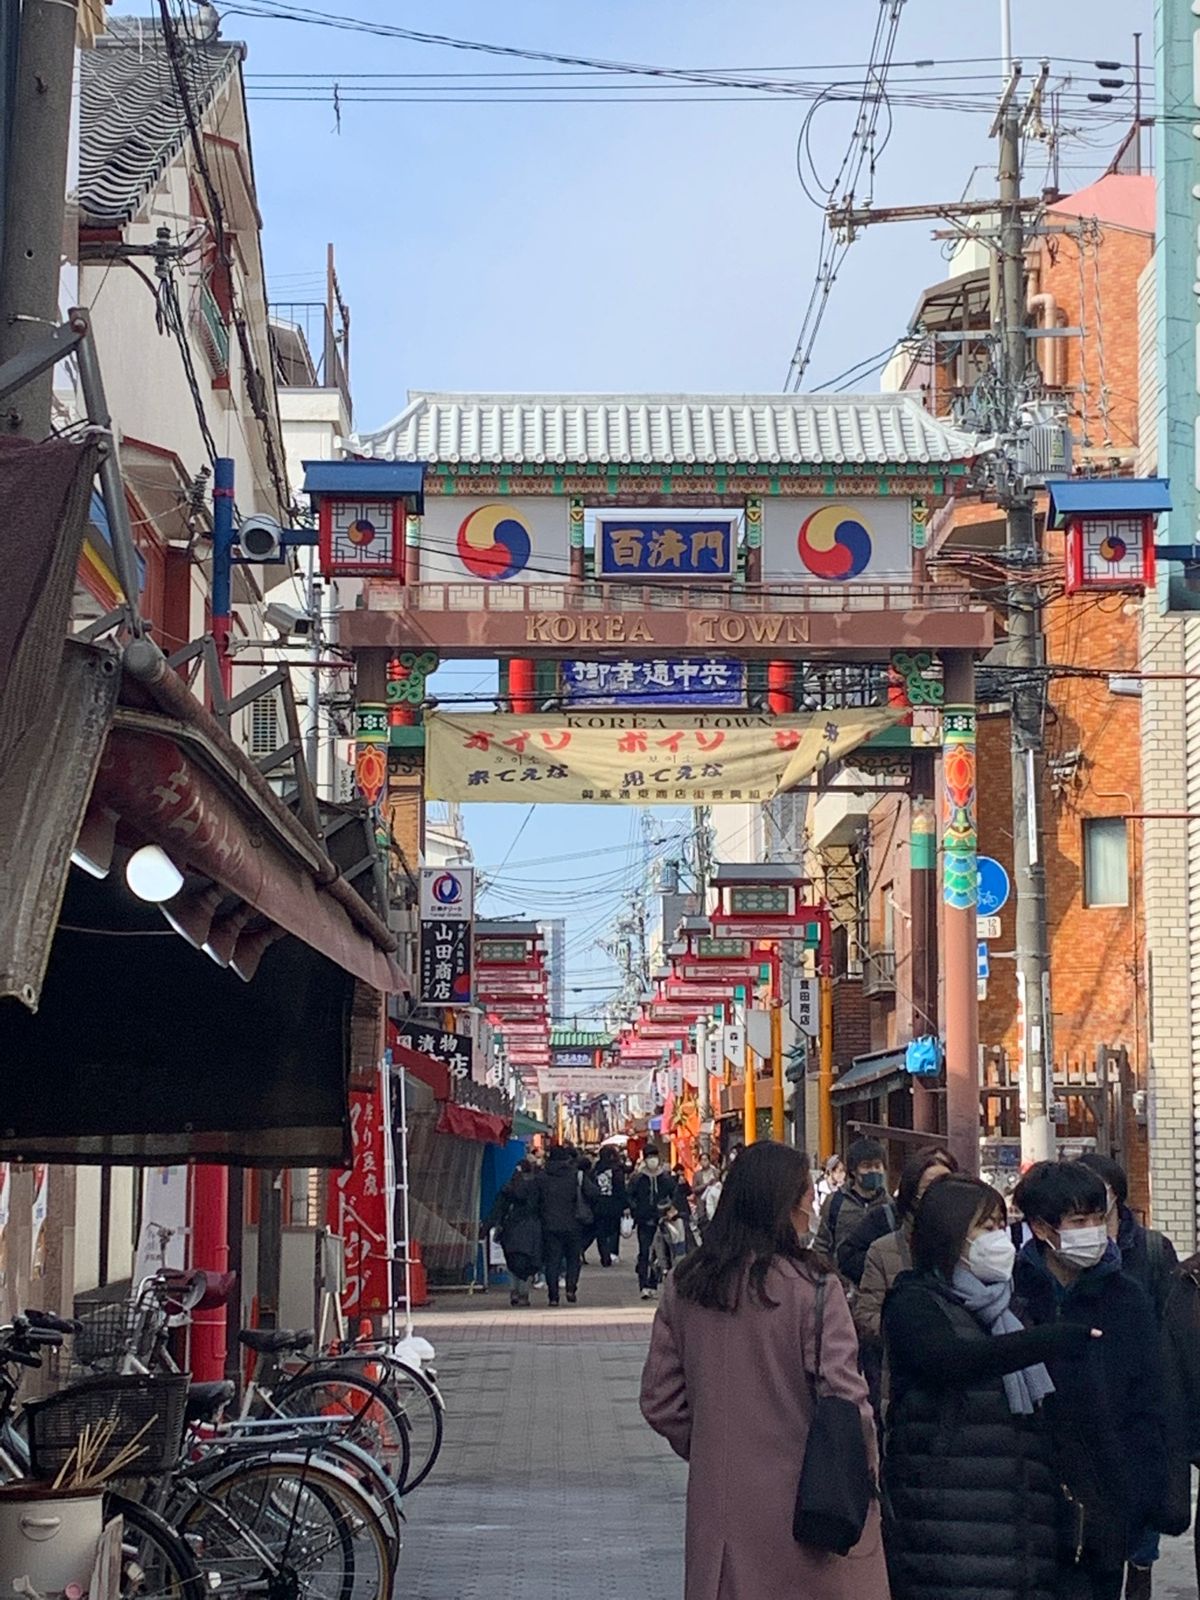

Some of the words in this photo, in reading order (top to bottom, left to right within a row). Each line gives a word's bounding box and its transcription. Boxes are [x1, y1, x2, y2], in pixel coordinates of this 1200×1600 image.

[525, 614, 655, 643] KOREA
[699, 614, 811, 643] TOWN
[567, 716, 667, 729] KOREA
[694, 716, 773, 729] TOWN
[433, 922, 454, 1000] 山田商店
